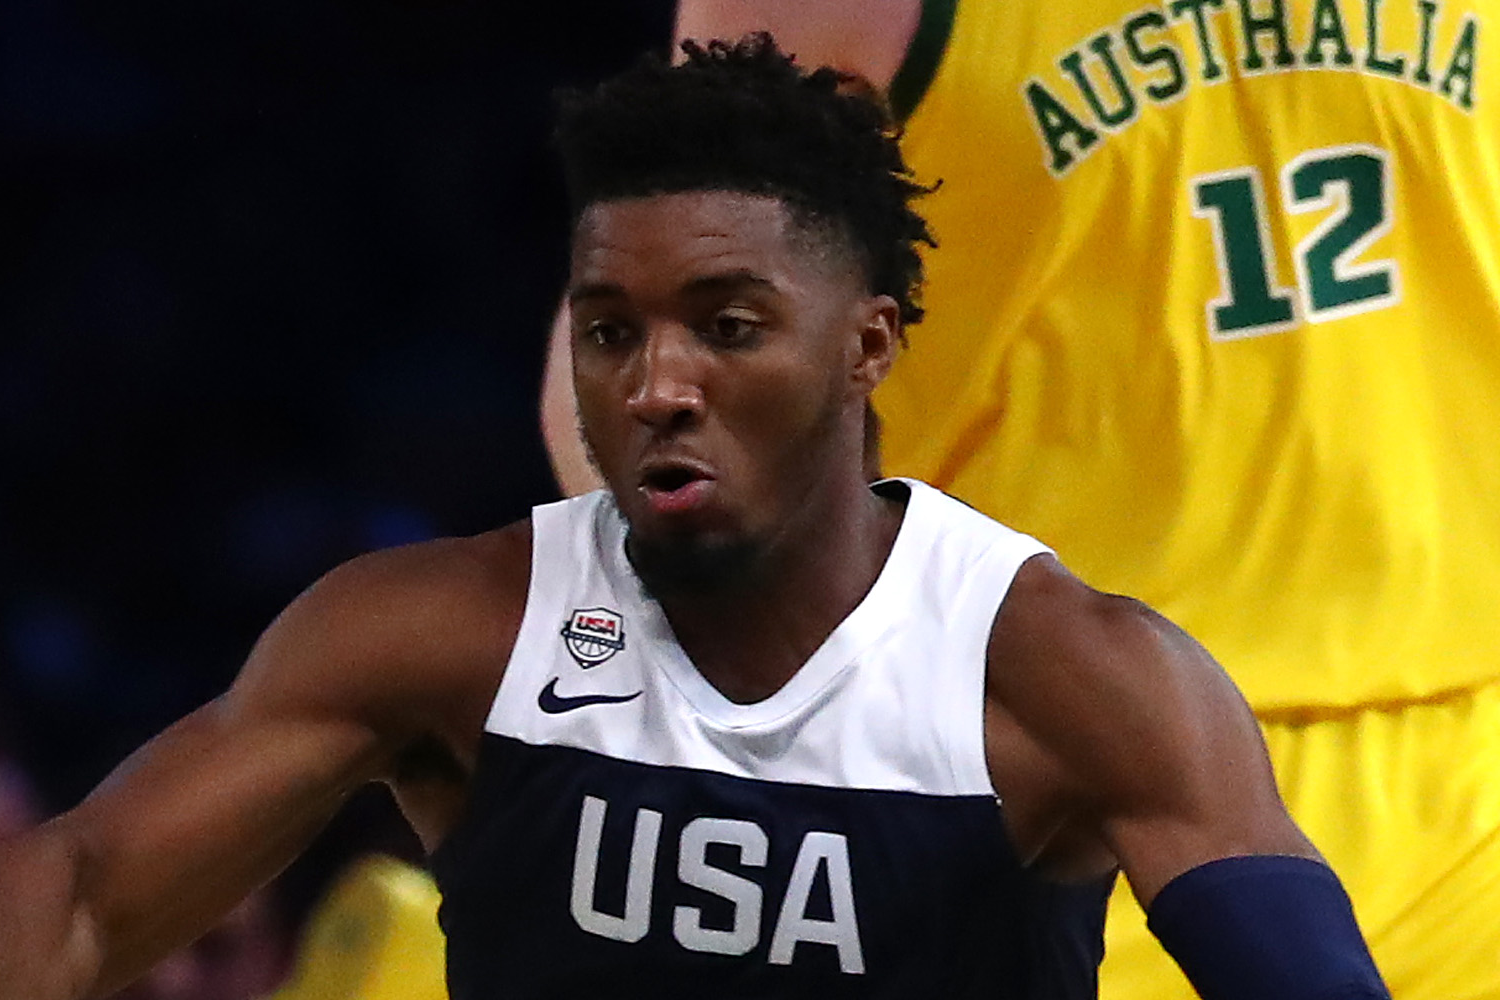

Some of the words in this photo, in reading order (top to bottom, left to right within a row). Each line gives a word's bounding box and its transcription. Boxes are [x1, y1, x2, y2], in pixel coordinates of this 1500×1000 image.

[1022, 0, 1479, 180] AUSTRALIA
[1190, 143, 1401, 341] 12
[576, 614, 616, 637] USA
[569, 795, 866, 975] USA
